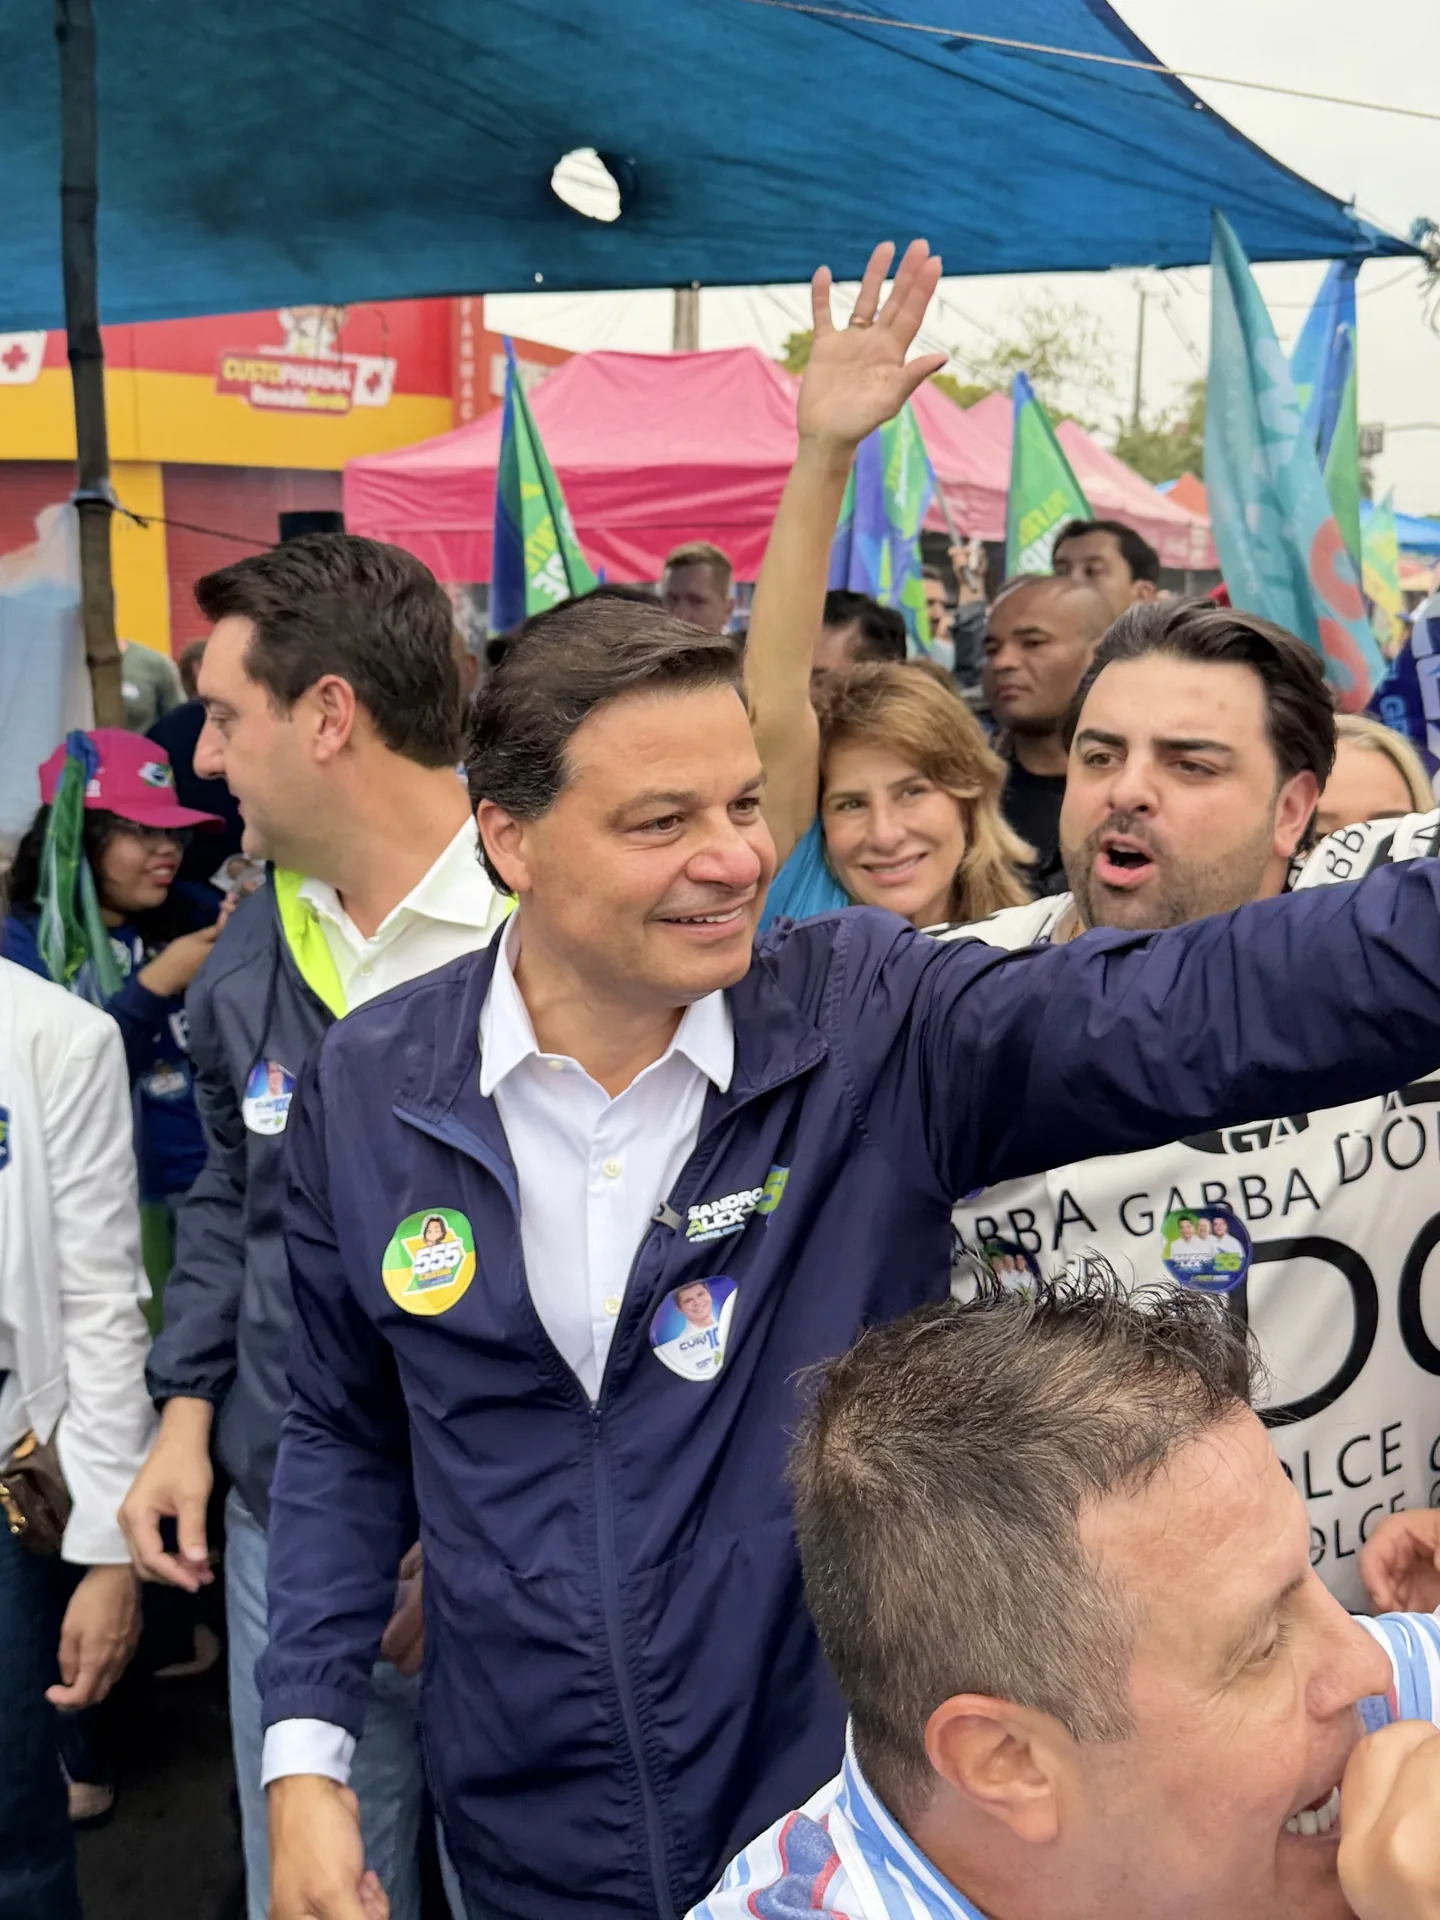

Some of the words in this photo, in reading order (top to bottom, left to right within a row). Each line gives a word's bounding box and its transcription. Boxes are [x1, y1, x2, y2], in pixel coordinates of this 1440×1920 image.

[688, 1187, 763, 1219] SANDRO
[685, 1207, 745, 1236] ALEX
[414, 1239, 463, 1274] 555
[1280, 1421, 1402, 1499] LCE
